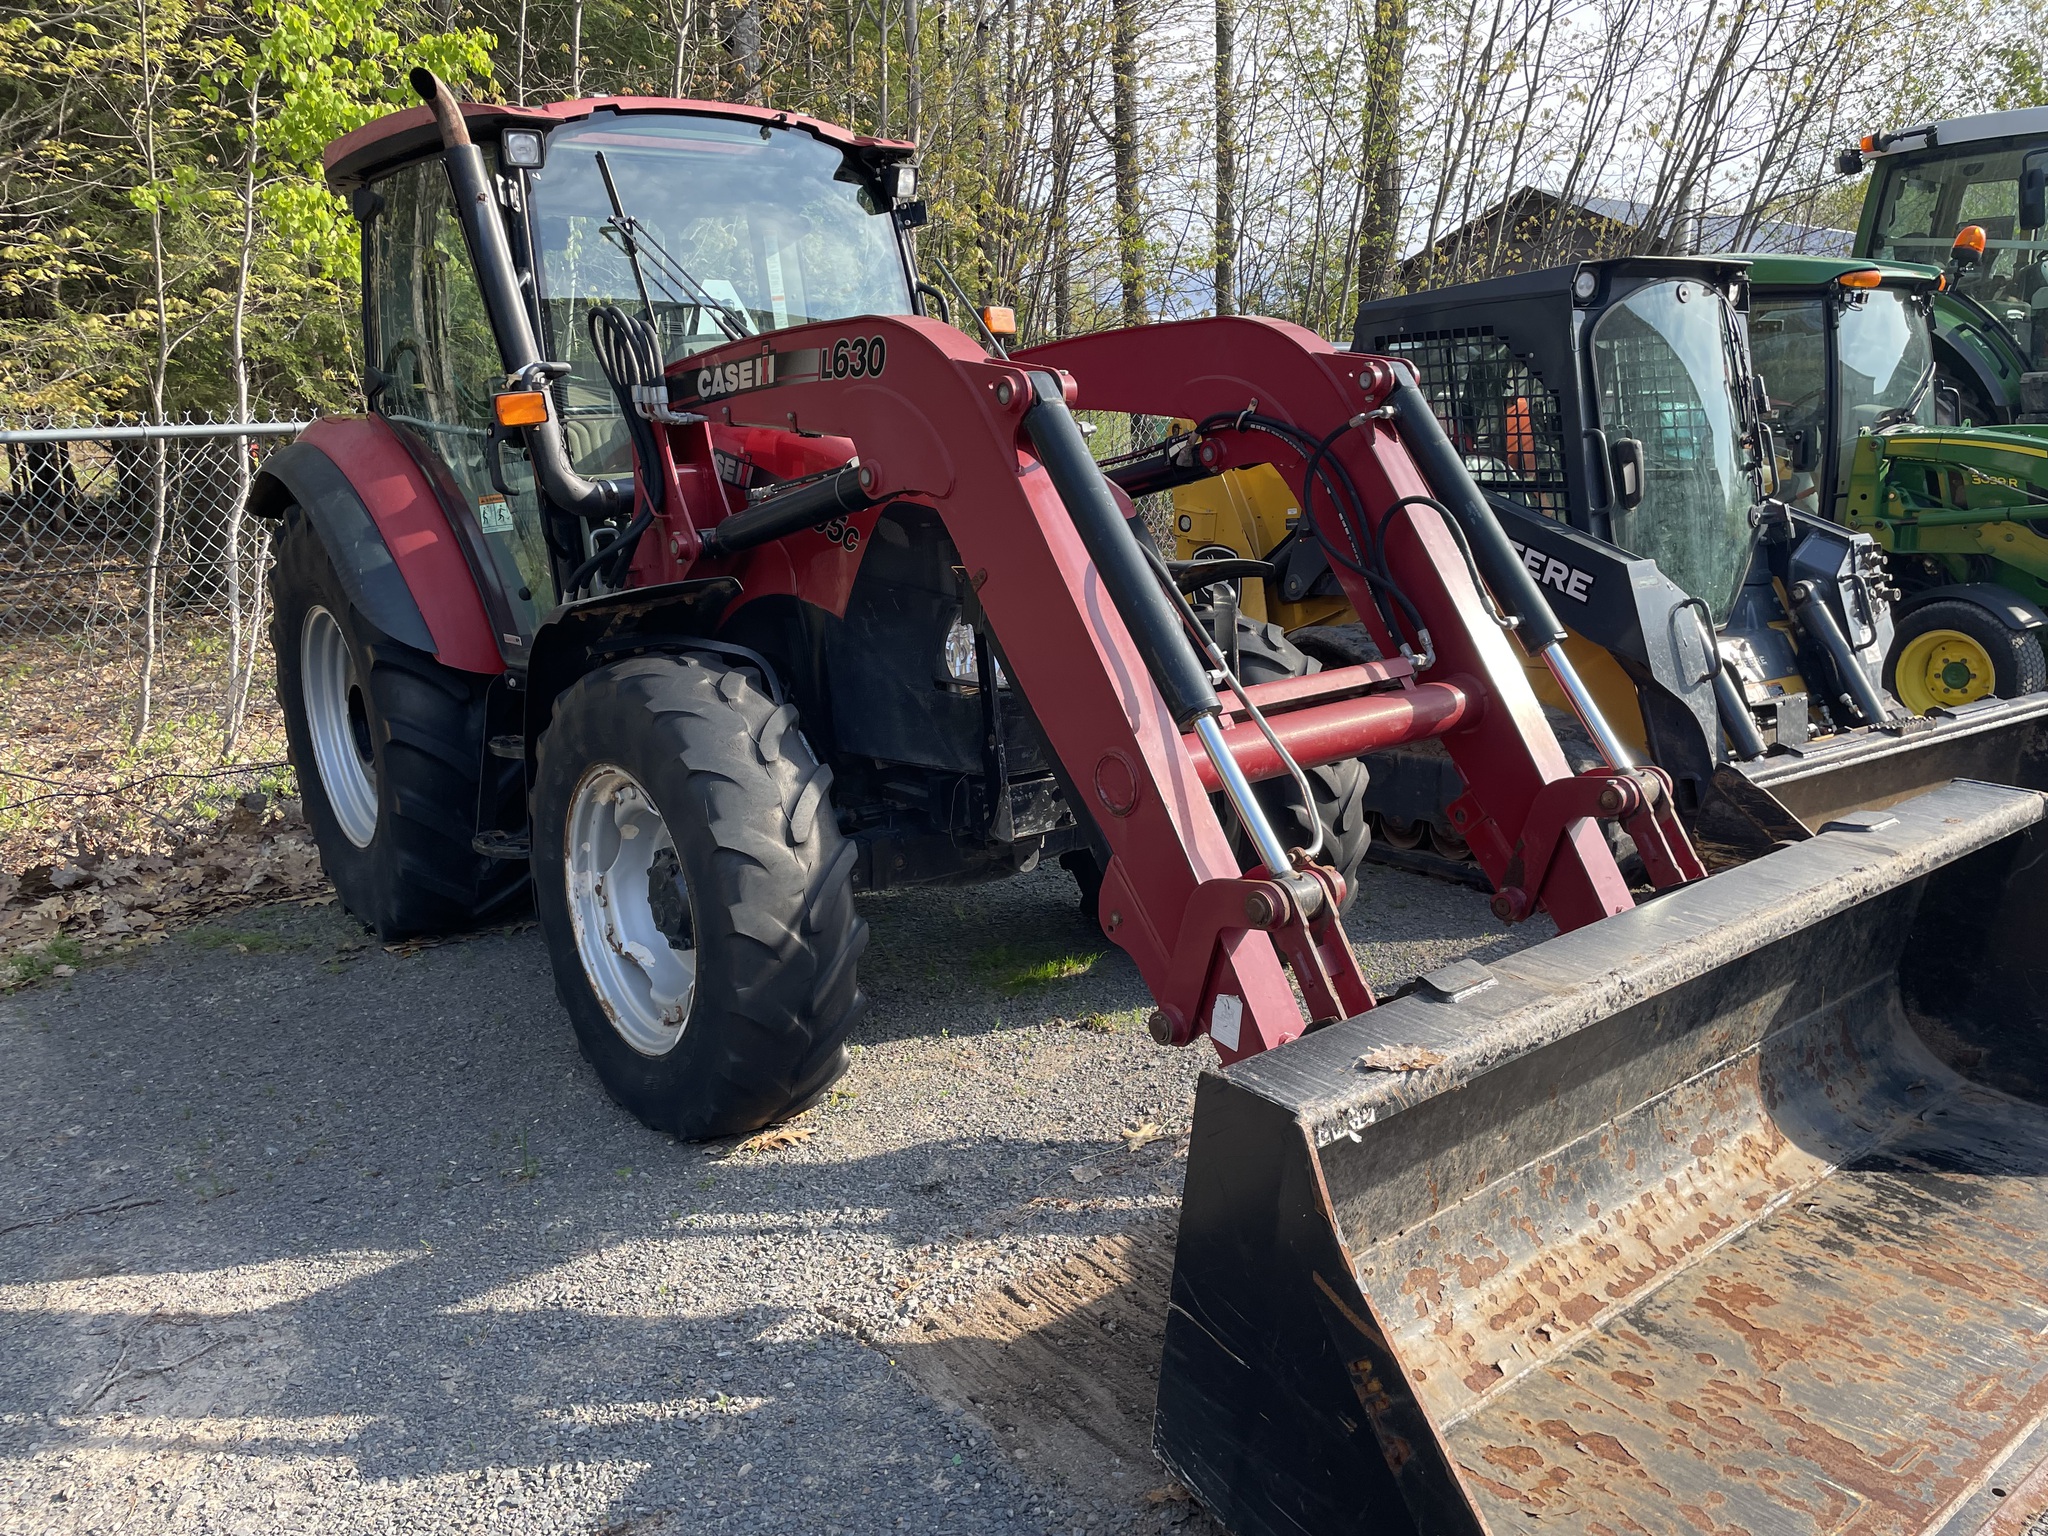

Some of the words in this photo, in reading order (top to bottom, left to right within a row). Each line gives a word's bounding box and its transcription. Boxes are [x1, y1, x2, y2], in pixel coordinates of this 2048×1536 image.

[820, 334, 887, 382] L630
[812, 515, 860, 553] 5C
[1509, 540, 1594, 603] ERE
